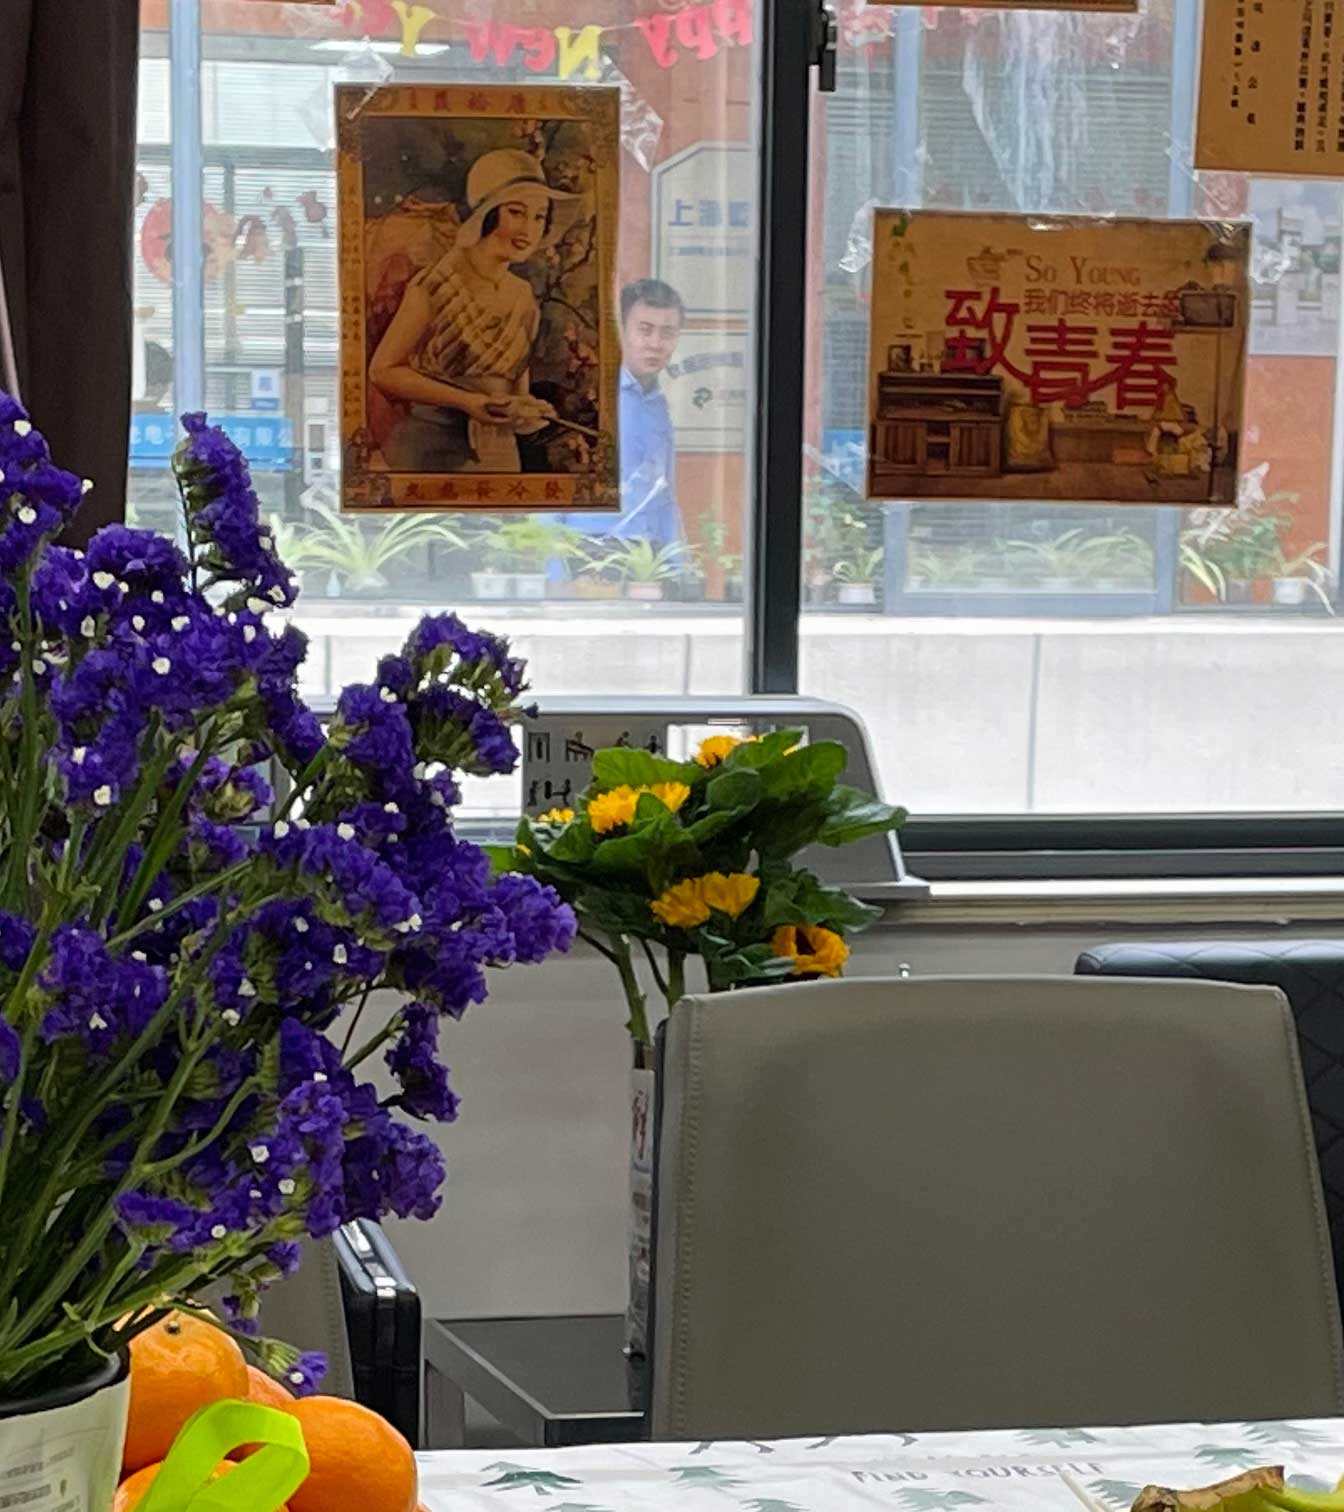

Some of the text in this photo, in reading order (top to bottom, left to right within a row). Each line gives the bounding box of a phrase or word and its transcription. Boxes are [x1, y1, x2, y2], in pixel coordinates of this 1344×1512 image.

[944, 286, 1178, 410] 致青春
[853, 1468, 929, 1485] FIND
